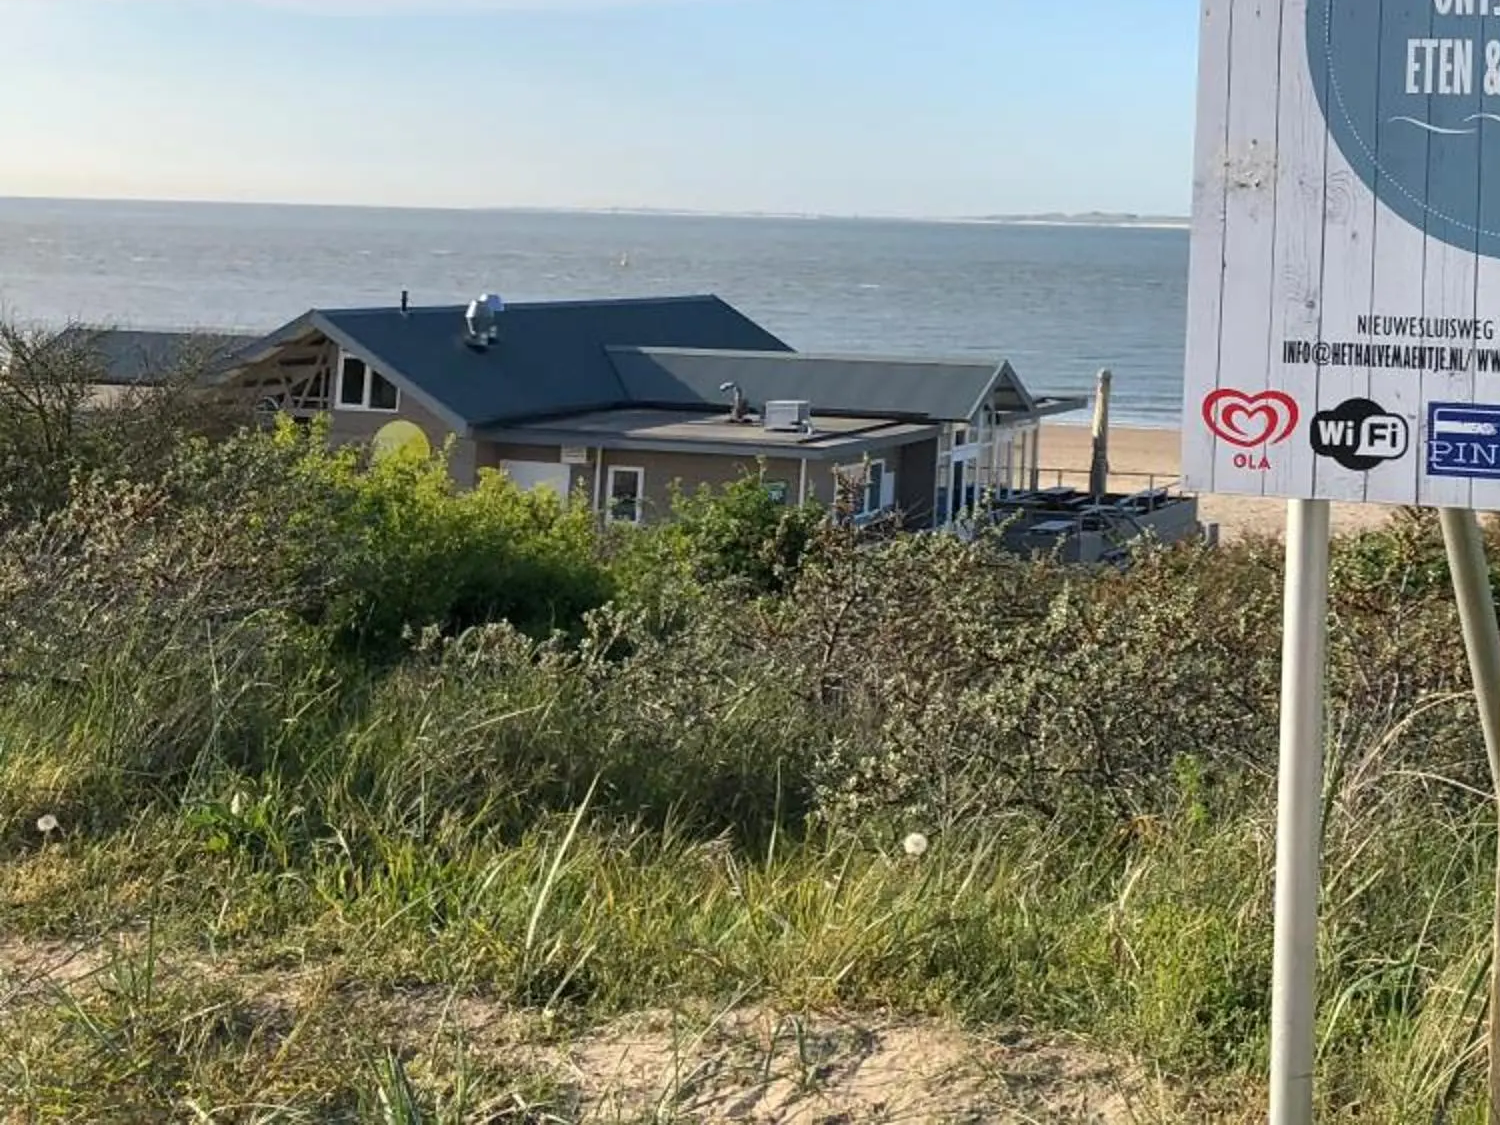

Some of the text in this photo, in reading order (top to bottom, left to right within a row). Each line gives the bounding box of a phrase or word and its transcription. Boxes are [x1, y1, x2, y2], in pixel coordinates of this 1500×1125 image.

[1404, 38, 1474, 95] ETEN
[1356, 314, 1494, 340] NIEUWESLUISWEG
[1233, 453, 1271, 470] OLA
[1429, 440, 1499, 465] PIN
